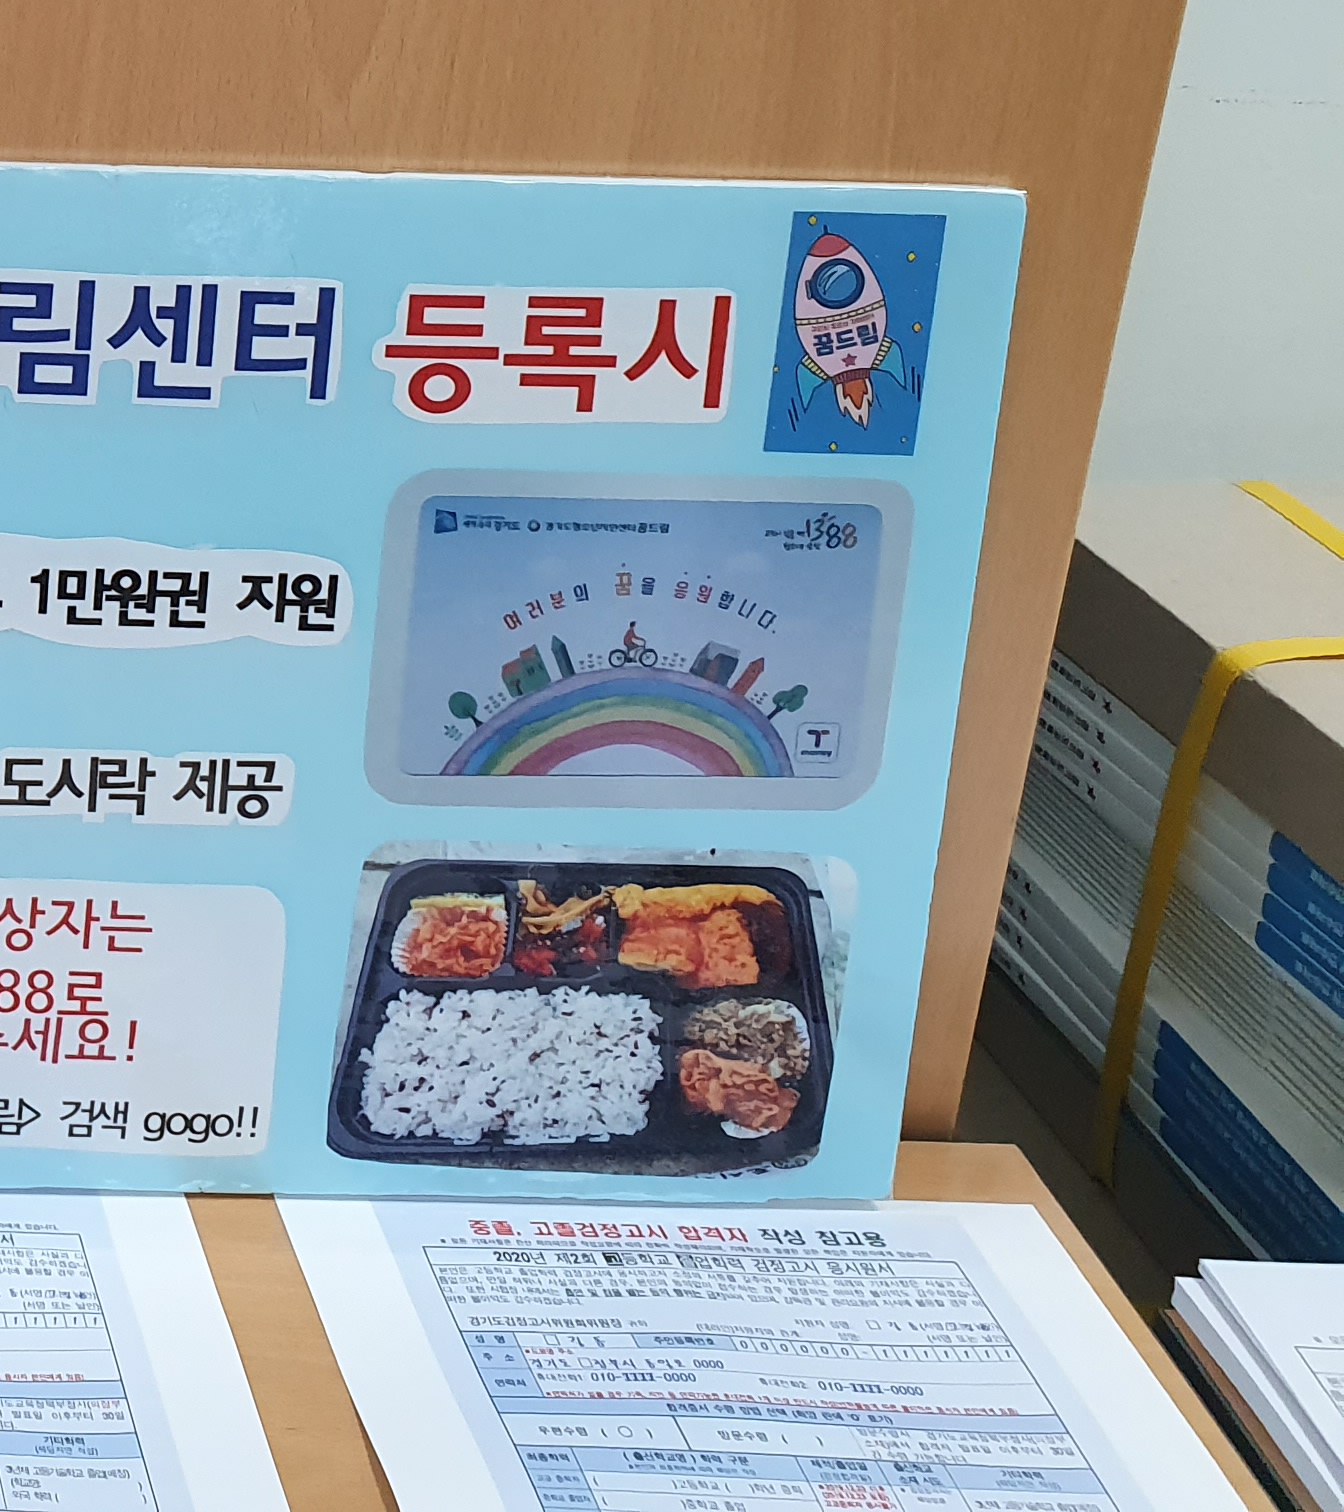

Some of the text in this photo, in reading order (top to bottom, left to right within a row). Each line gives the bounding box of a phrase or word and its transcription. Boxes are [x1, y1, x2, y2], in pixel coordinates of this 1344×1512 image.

[383, 293, 732, 413] 등록시
[812, 321, 879, 357] 꿈드림
[29, 566, 210, 629] 1만원권
[236, 572, 339, 632] 지원
[503, 583, 589, 630] 여러분의
[615, 572, 656, 596] 꿈을
[173, 758, 284, 821] 제공
[57, 1099, 128, 1142] 검색
[141, 1103, 260, 1144] gogo!!
[530, 1221, 668, 1239] 고졸검정고시
[676, 1226, 748, 1243] 합격자
[758, 1228, 806, 1246] 작성
[815, 1230, 888, 1248] 참고용
[492, 1250, 546, 1264] 2020년
[554, 1252, 598, 1265] 제2회
[601, 1252, 673, 1266] 고등학교
[753, 1258, 820, 1275] 검정고시
[827, 1262, 896, 1276] 응시원서
[693, 1359, 724, 1369] 0000
[538, 1426, 768, 1442] 우편수령 방문수령
[727, 1455, 750, 1466] 구분
